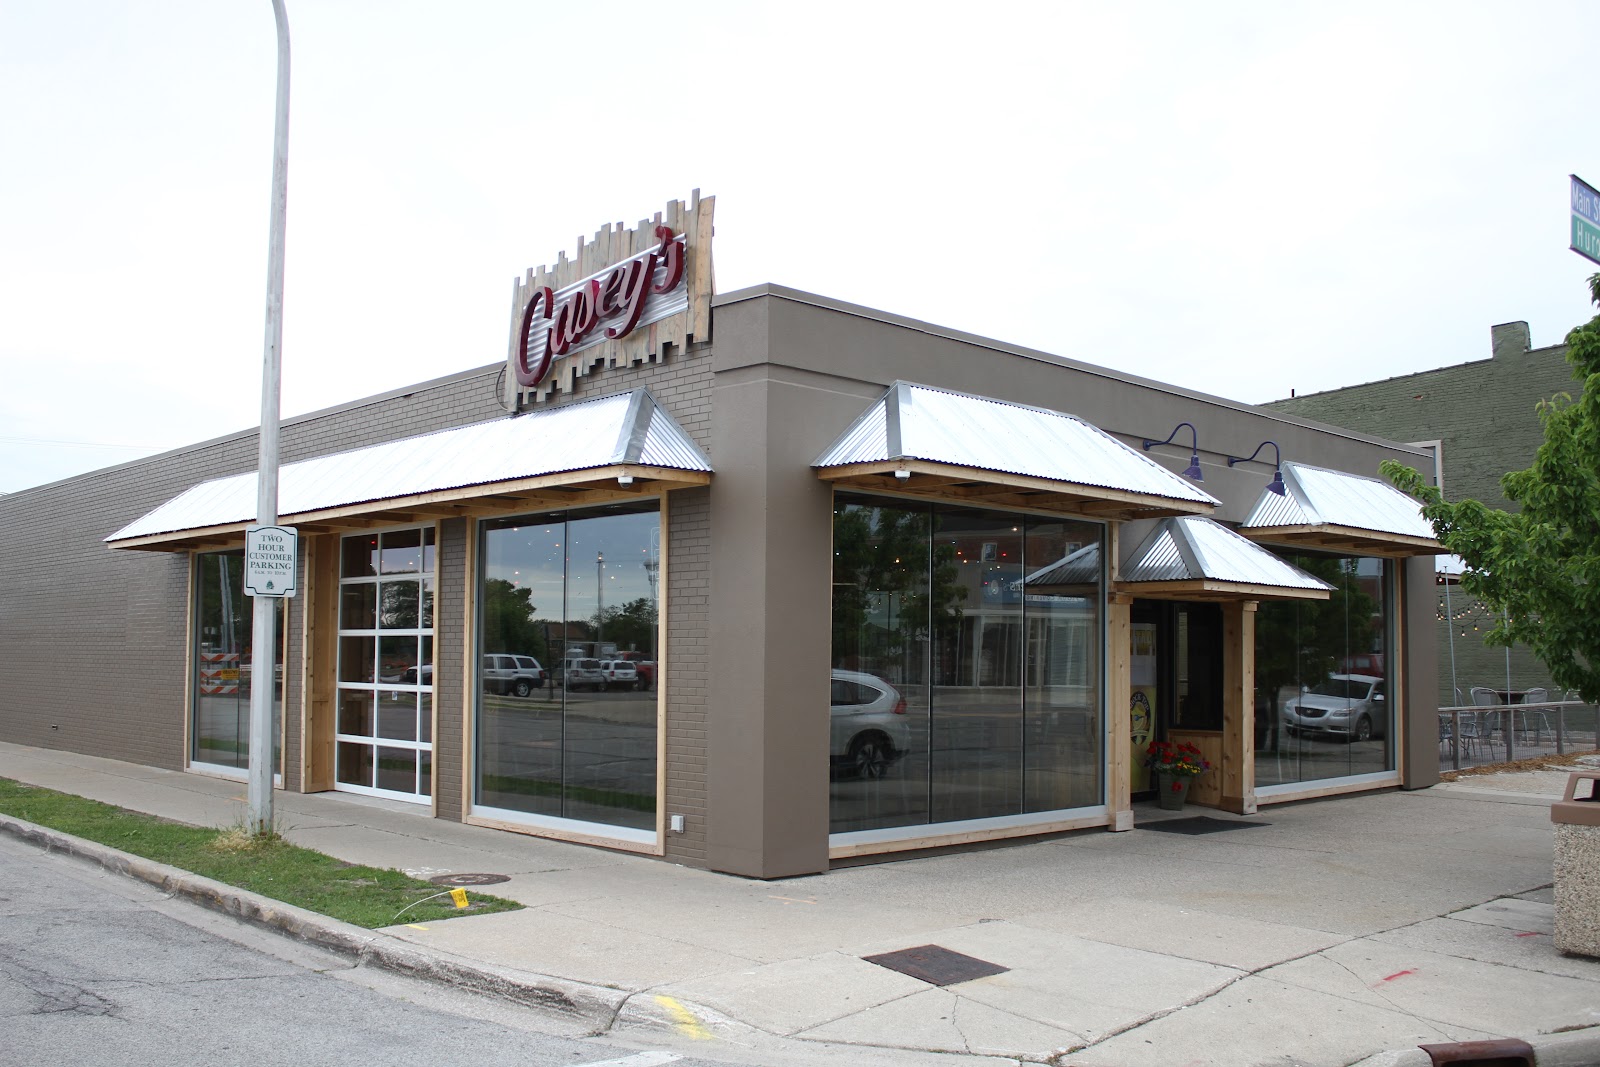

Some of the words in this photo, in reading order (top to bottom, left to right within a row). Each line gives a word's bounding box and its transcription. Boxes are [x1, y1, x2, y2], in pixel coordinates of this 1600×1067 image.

[1572, 183, 1591, 217] Main
[514, 225, 685, 387] Casey's
[261, 534, 283, 542] TWO
[258, 543, 285, 552] HOUR
[249, 552, 293, 561] CUSTOMER
[250, 561, 292, 570] PARKING
